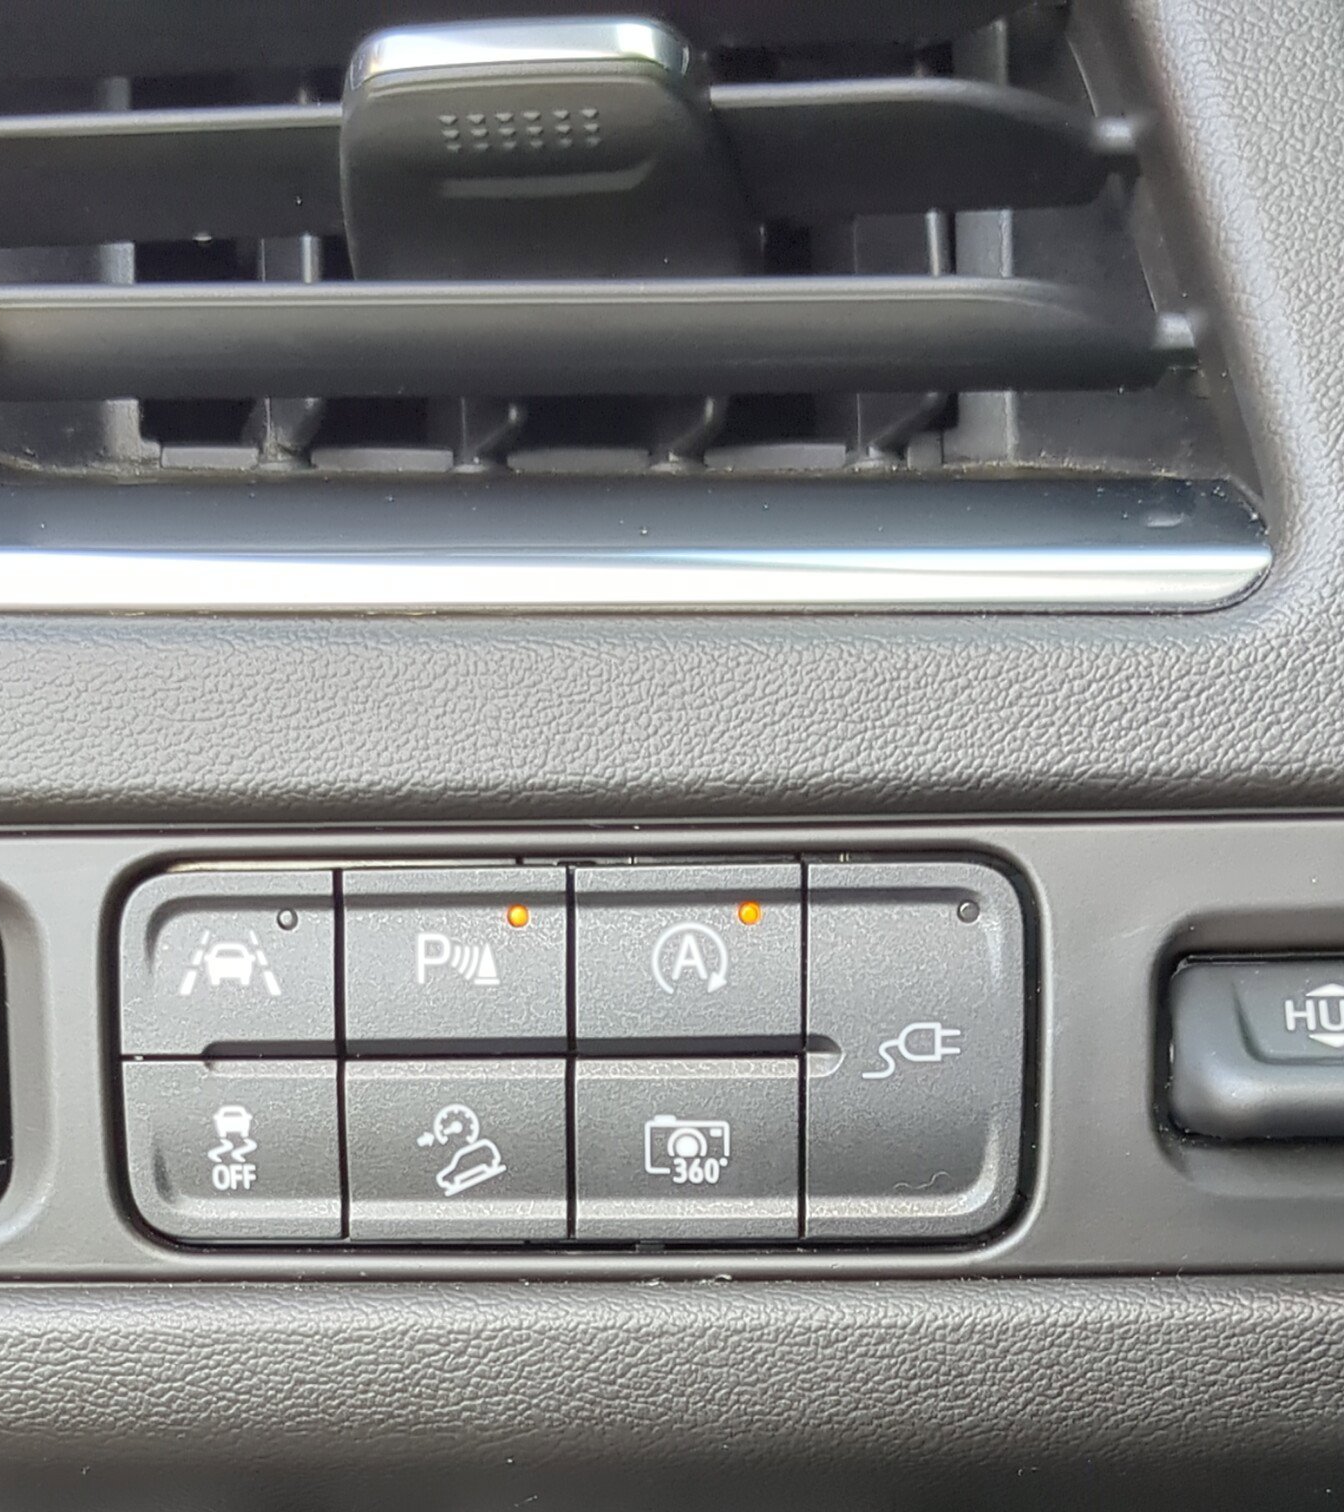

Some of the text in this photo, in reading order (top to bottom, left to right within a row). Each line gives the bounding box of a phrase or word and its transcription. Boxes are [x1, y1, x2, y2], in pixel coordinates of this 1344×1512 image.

[417, 934, 451, 984] P
[671, 940, 706, 979] A
[212, 1165, 256, 1191] OFF
